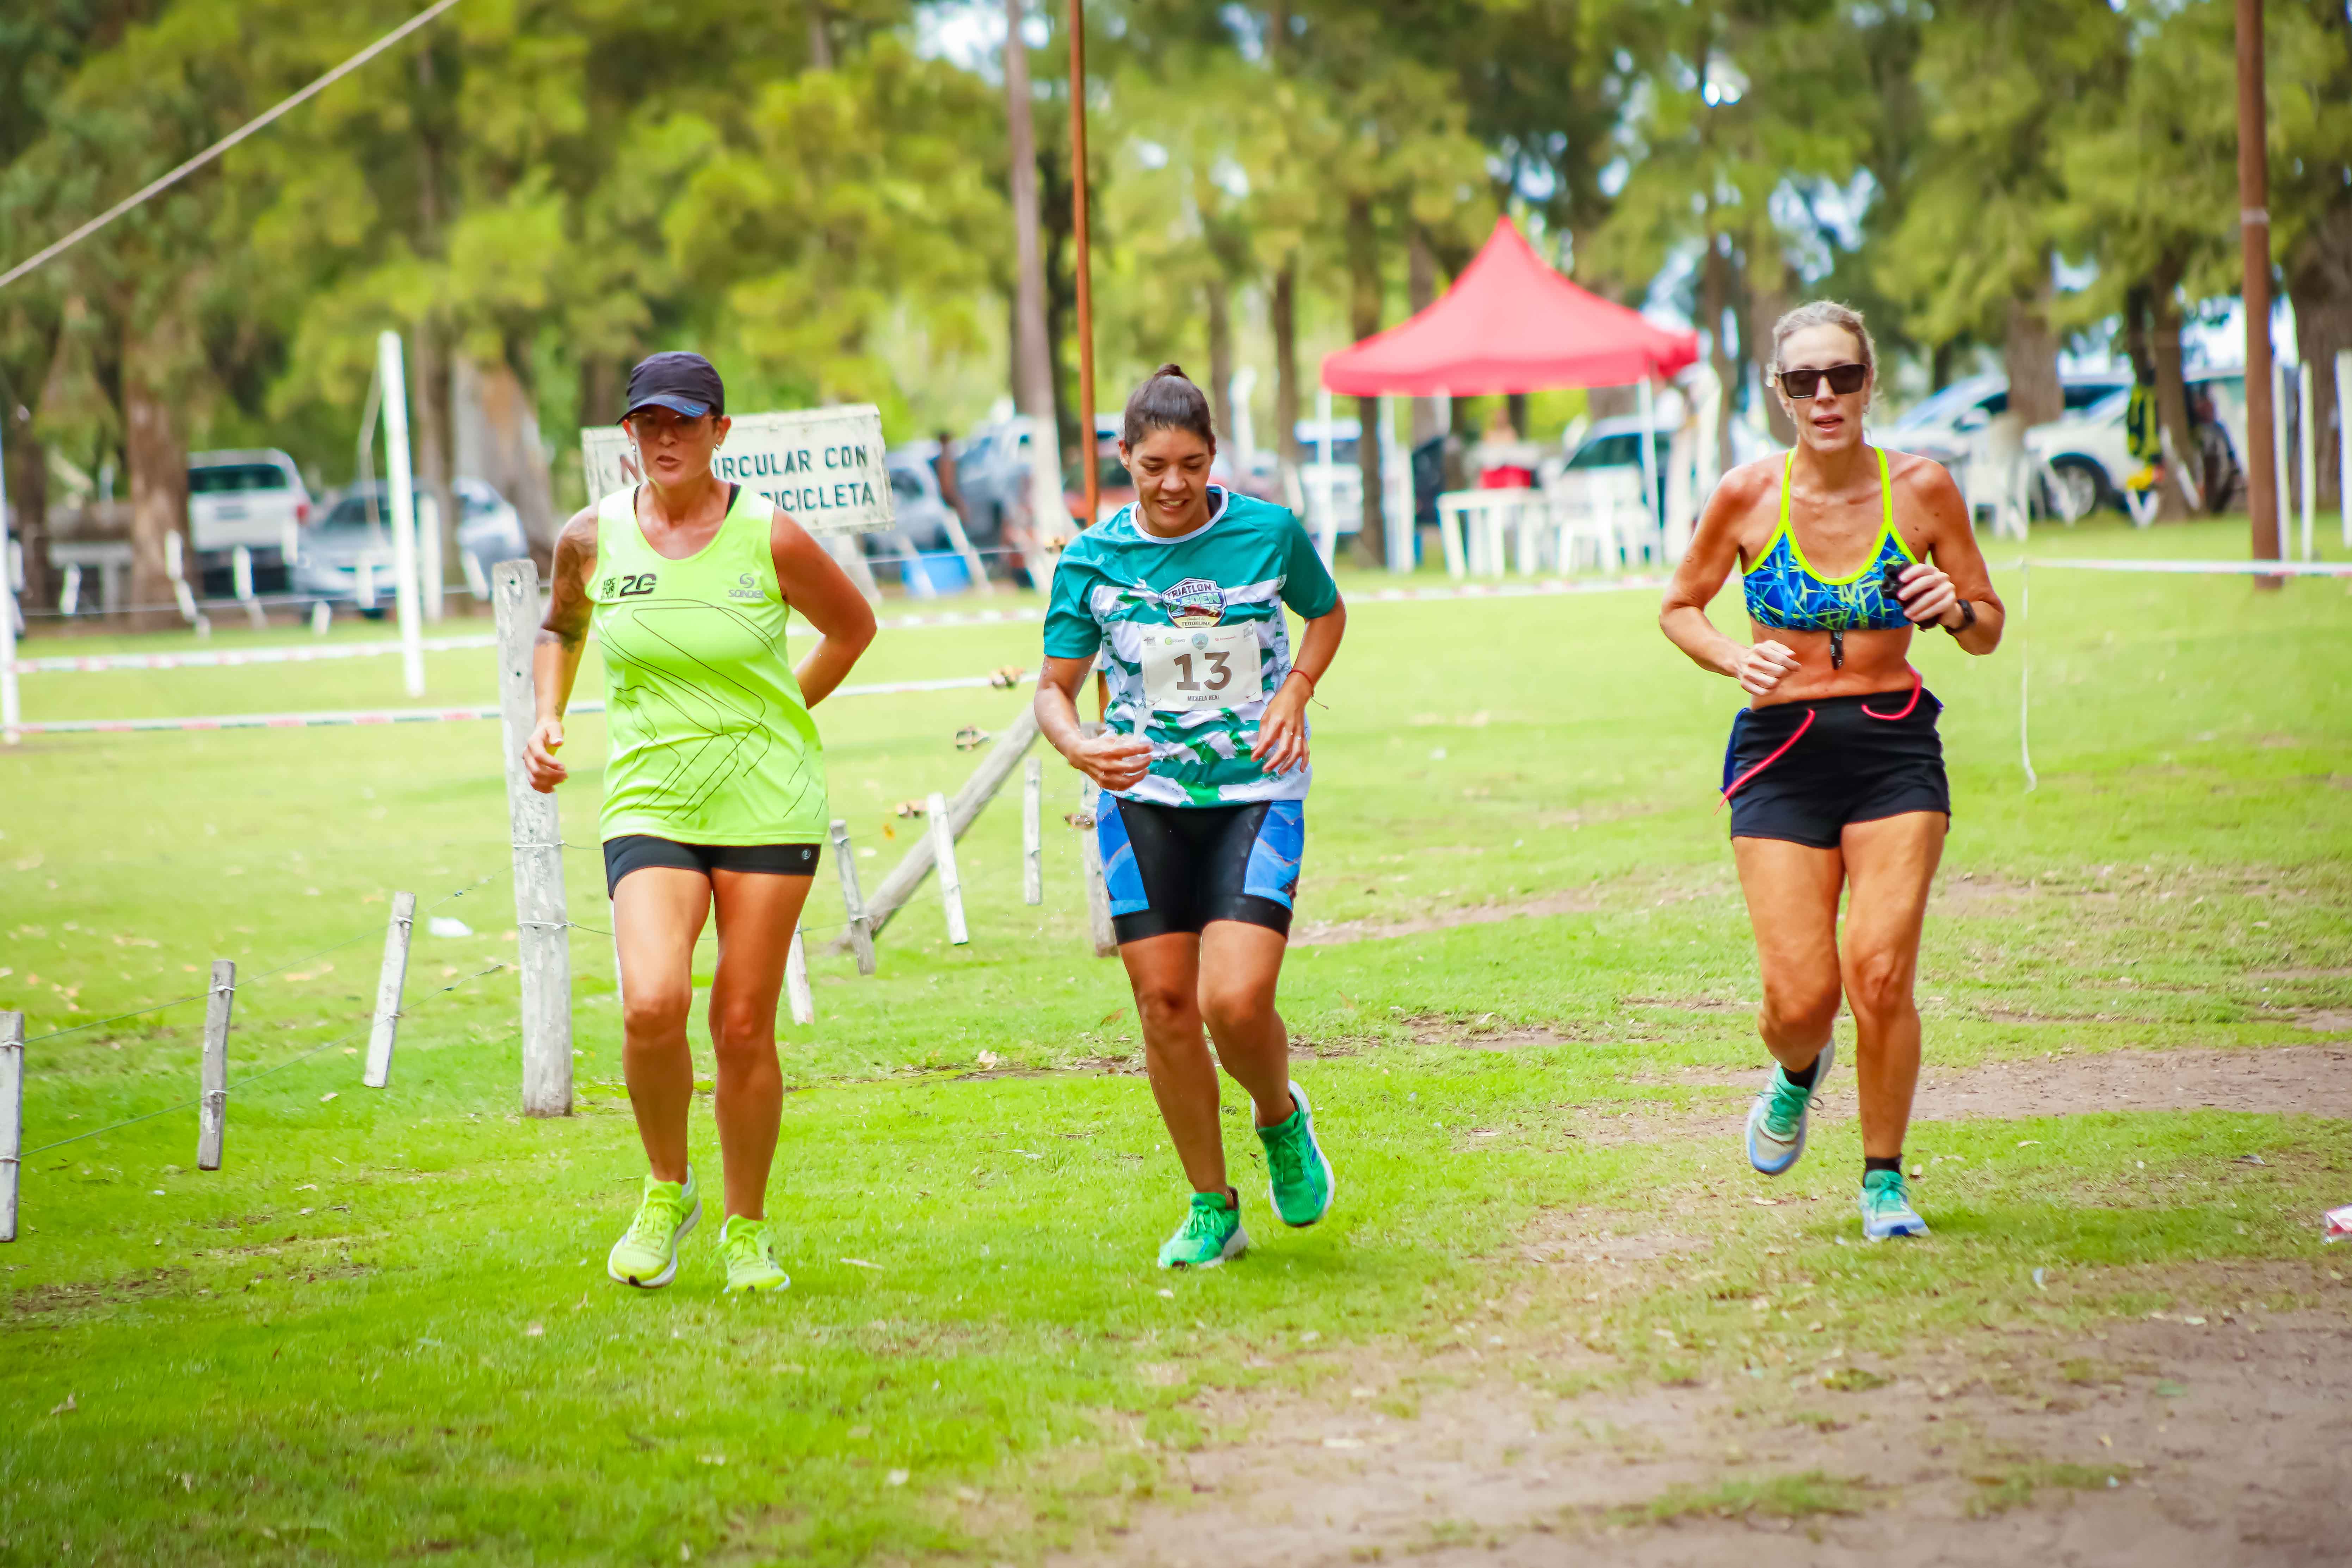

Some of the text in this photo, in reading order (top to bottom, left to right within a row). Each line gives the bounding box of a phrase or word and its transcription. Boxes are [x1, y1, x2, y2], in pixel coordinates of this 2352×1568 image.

[620, 445, 869, 485] N IRCULAR CON
[1167, 583, 1212, 599] TRIATLON
[1182, 592, 1221, 604] EDEN
[1174, 651, 1232, 690] 13
